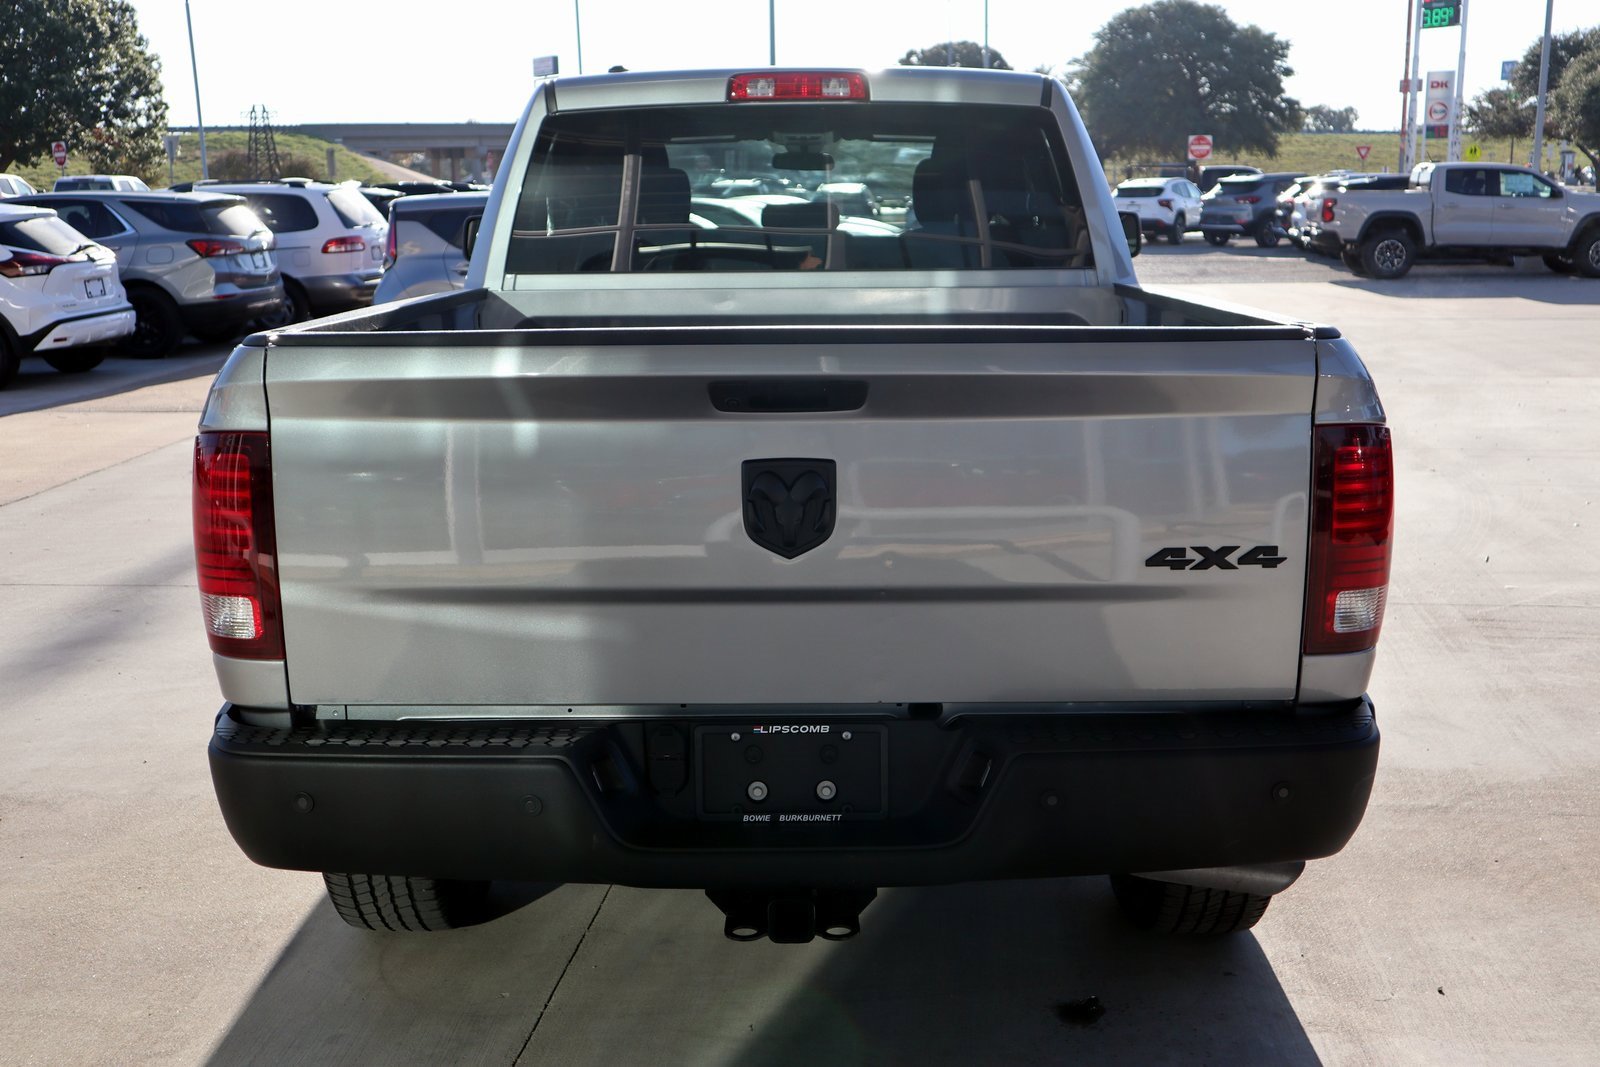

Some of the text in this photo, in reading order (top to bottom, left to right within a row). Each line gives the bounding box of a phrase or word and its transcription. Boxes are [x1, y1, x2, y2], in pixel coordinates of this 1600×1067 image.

[1430, 80, 1449, 89] DK
[1145, 545, 1288, 570] 4X4
[759, 725, 830, 734] LIPSCOMB
[743, 814, 842, 822] BOWIE BURKBURNETT
